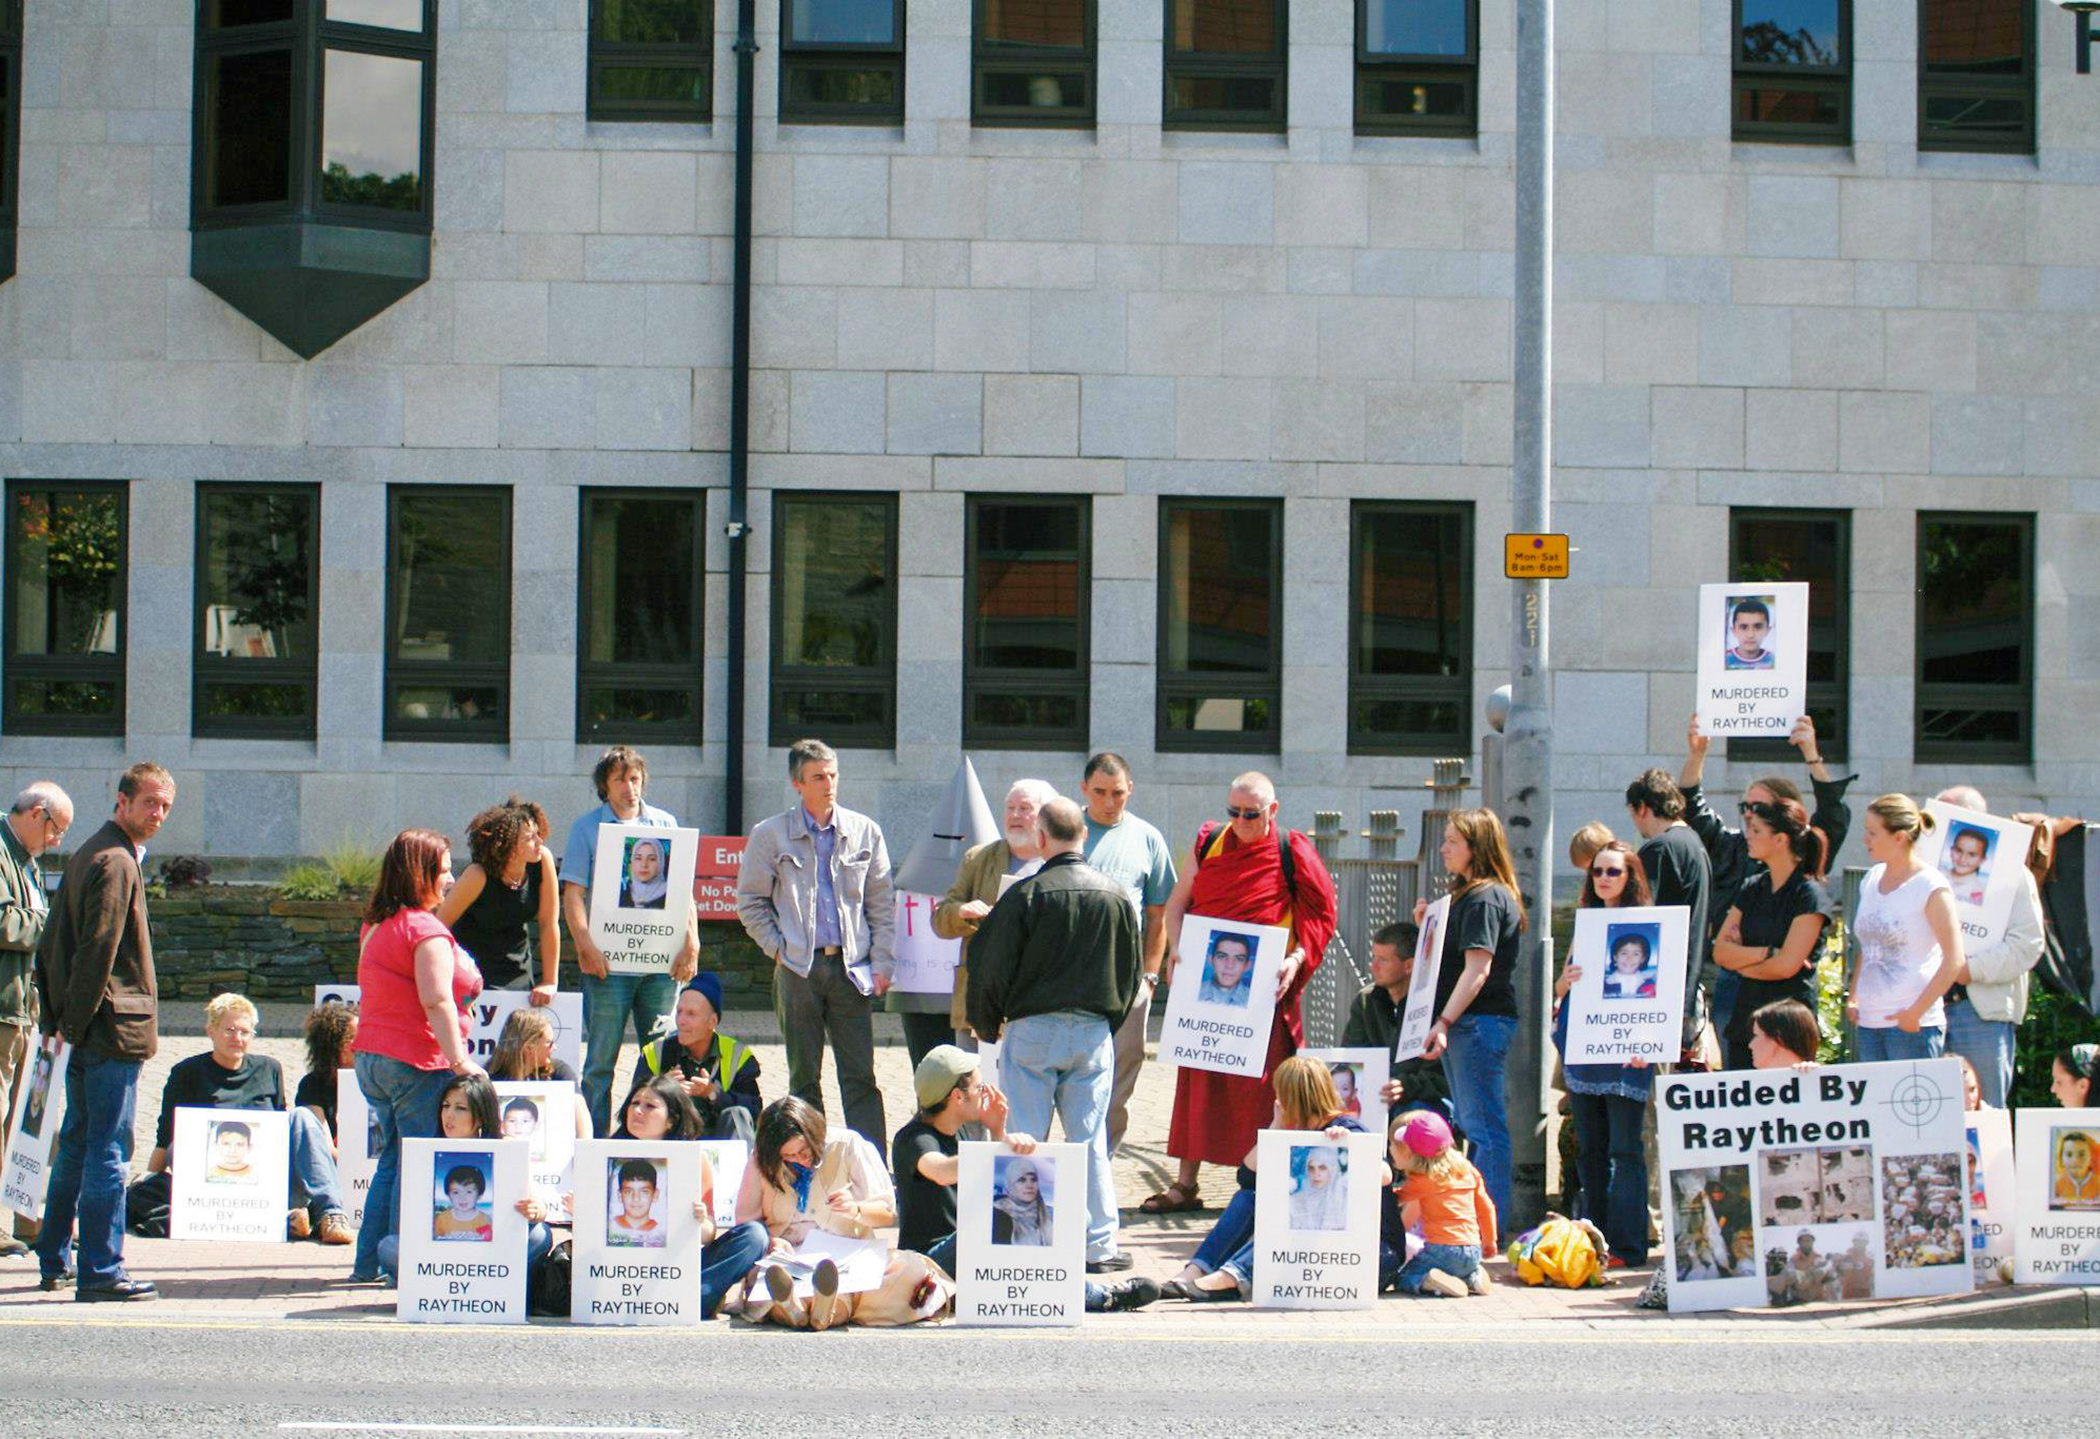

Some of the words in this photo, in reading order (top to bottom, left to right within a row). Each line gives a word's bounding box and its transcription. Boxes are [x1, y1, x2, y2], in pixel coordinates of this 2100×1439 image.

[1711, 687, 1789, 700] MURDERED
[1738, 702, 1756, 714] BY
[1712, 716, 1787, 729] RAYTHEON
[701, 885, 720, 897] No
[603, 922, 674, 936] MURDERED
[627, 938, 645, 949] BY
[603, 950, 670, 964] RAYTHEON
[1585, 1012, 1667, 1025] MURDERED
[1177, 1017, 1254, 1039] MURDERED
[1613, 1028, 1632, 1040] BY
[1201, 1035, 1220, 1047] BY
[1585, 1042, 1664, 1055] RAYTHEON
[1174, 1046, 1247, 1067] RAYTHEON
[1665, 1077, 1801, 1111] Guided
[1820, 1075, 1867, 1106] By
[1683, 1118, 1870, 1153] Raytheon
[188, 1197, 270, 1209] MURDERED
[216, 1210, 233, 1221] BY
[189, 1222, 267, 1234] RAYTHEON
[2031, 1226, 2100, 1239] MURDERE
[2060, 1243, 2080, 1256] BY
[1272, 1250, 1361, 1265] MURDERED
[417, 1263, 509, 1278] MURDERED
[590, 1265, 682, 1280] MURDERED
[2032, 1260, 2100, 1273] RAYTHEO
[975, 1268, 1067, 1281] MURDERED
[1303, 1268, 1323, 1281] BY
[449, 1281, 470, 1294] BY
[621, 1283, 643, 1296] BY
[1007, 1286, 1028, 1299] BY
[1273, 1285, 1358, 1300] RAYTHEON
[418, 1298, 506, 1313] RAYTHEON
[591, 1300, 679, 1315] RAYTHEON
[977, 1303, 1065, 1317] RAYTHEON
